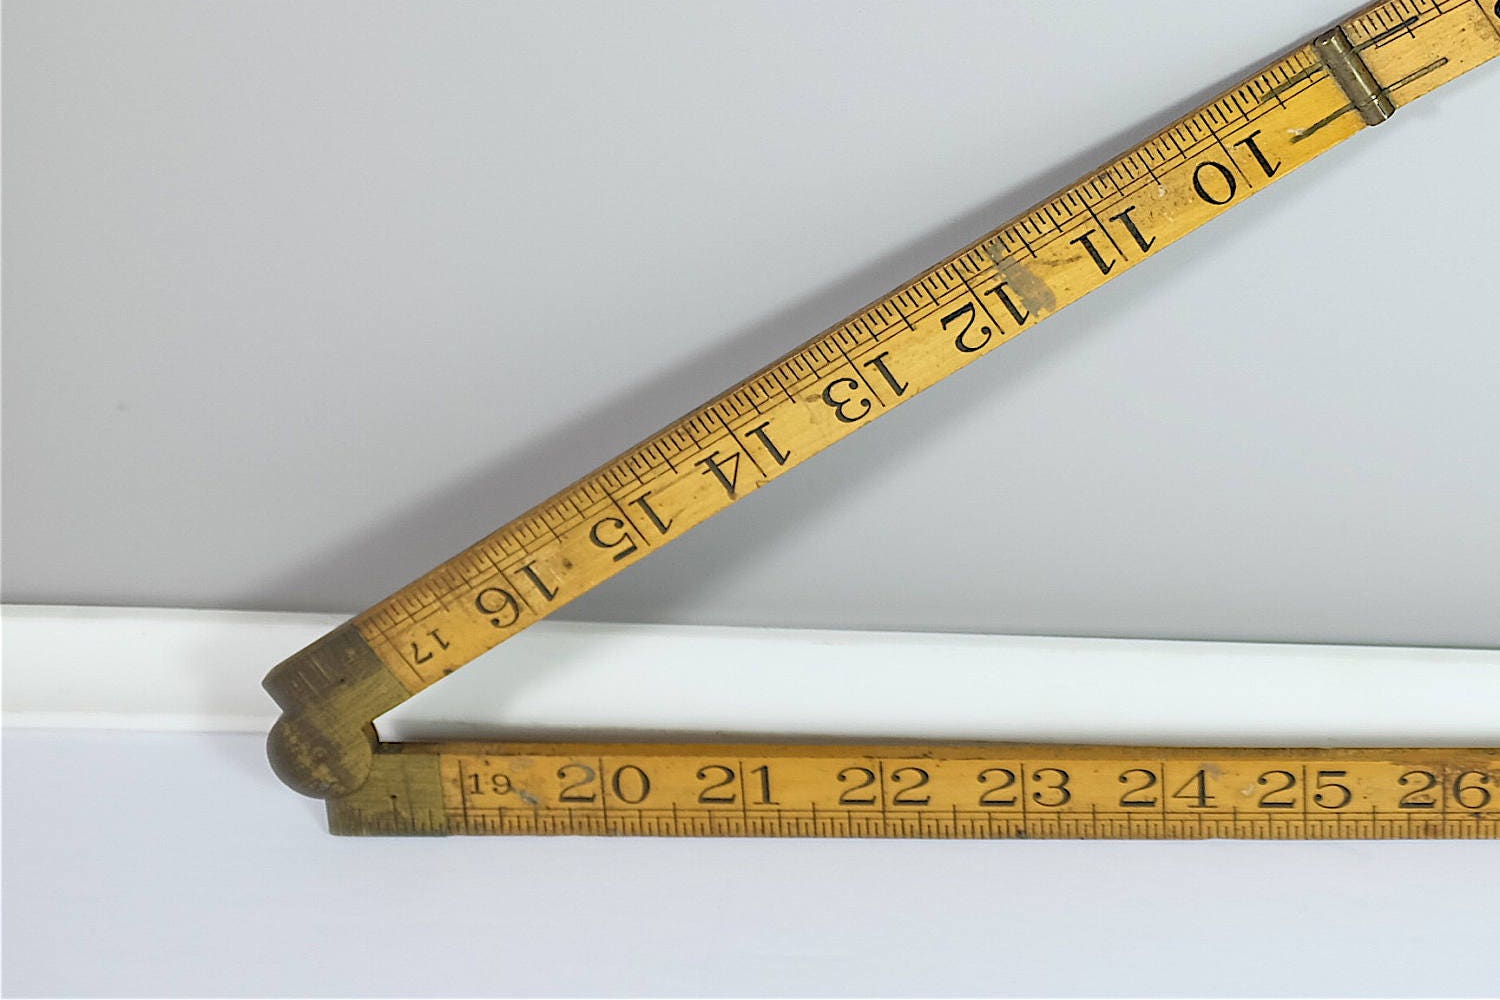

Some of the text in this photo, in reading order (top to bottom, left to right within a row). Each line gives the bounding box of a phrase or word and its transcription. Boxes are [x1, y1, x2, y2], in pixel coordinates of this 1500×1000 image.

[1191, 129, 1281, 205] 10
[1069, 205, 1156, 275] 11
[940, 281, 1030, 352] 12
[821, 351, 910, 423] 13
[694, 421, 791, 496] 14
[588, 491, 673, 562] 15
[474, 559, 559, 628] 16
[410, 628, 450, 665] 17
[468, 772, 511, 796] 19
[557, 764, 652, 805] 20
[695, 764, 781, 806] 21
[836, 766, 930, 806] 22
[976, 767, 1071, 807] 23
[1118, 768, 1218, 809] 24
[1257, 769, 1353, 809] 25
[1398, 769, 1493, 809] 26
